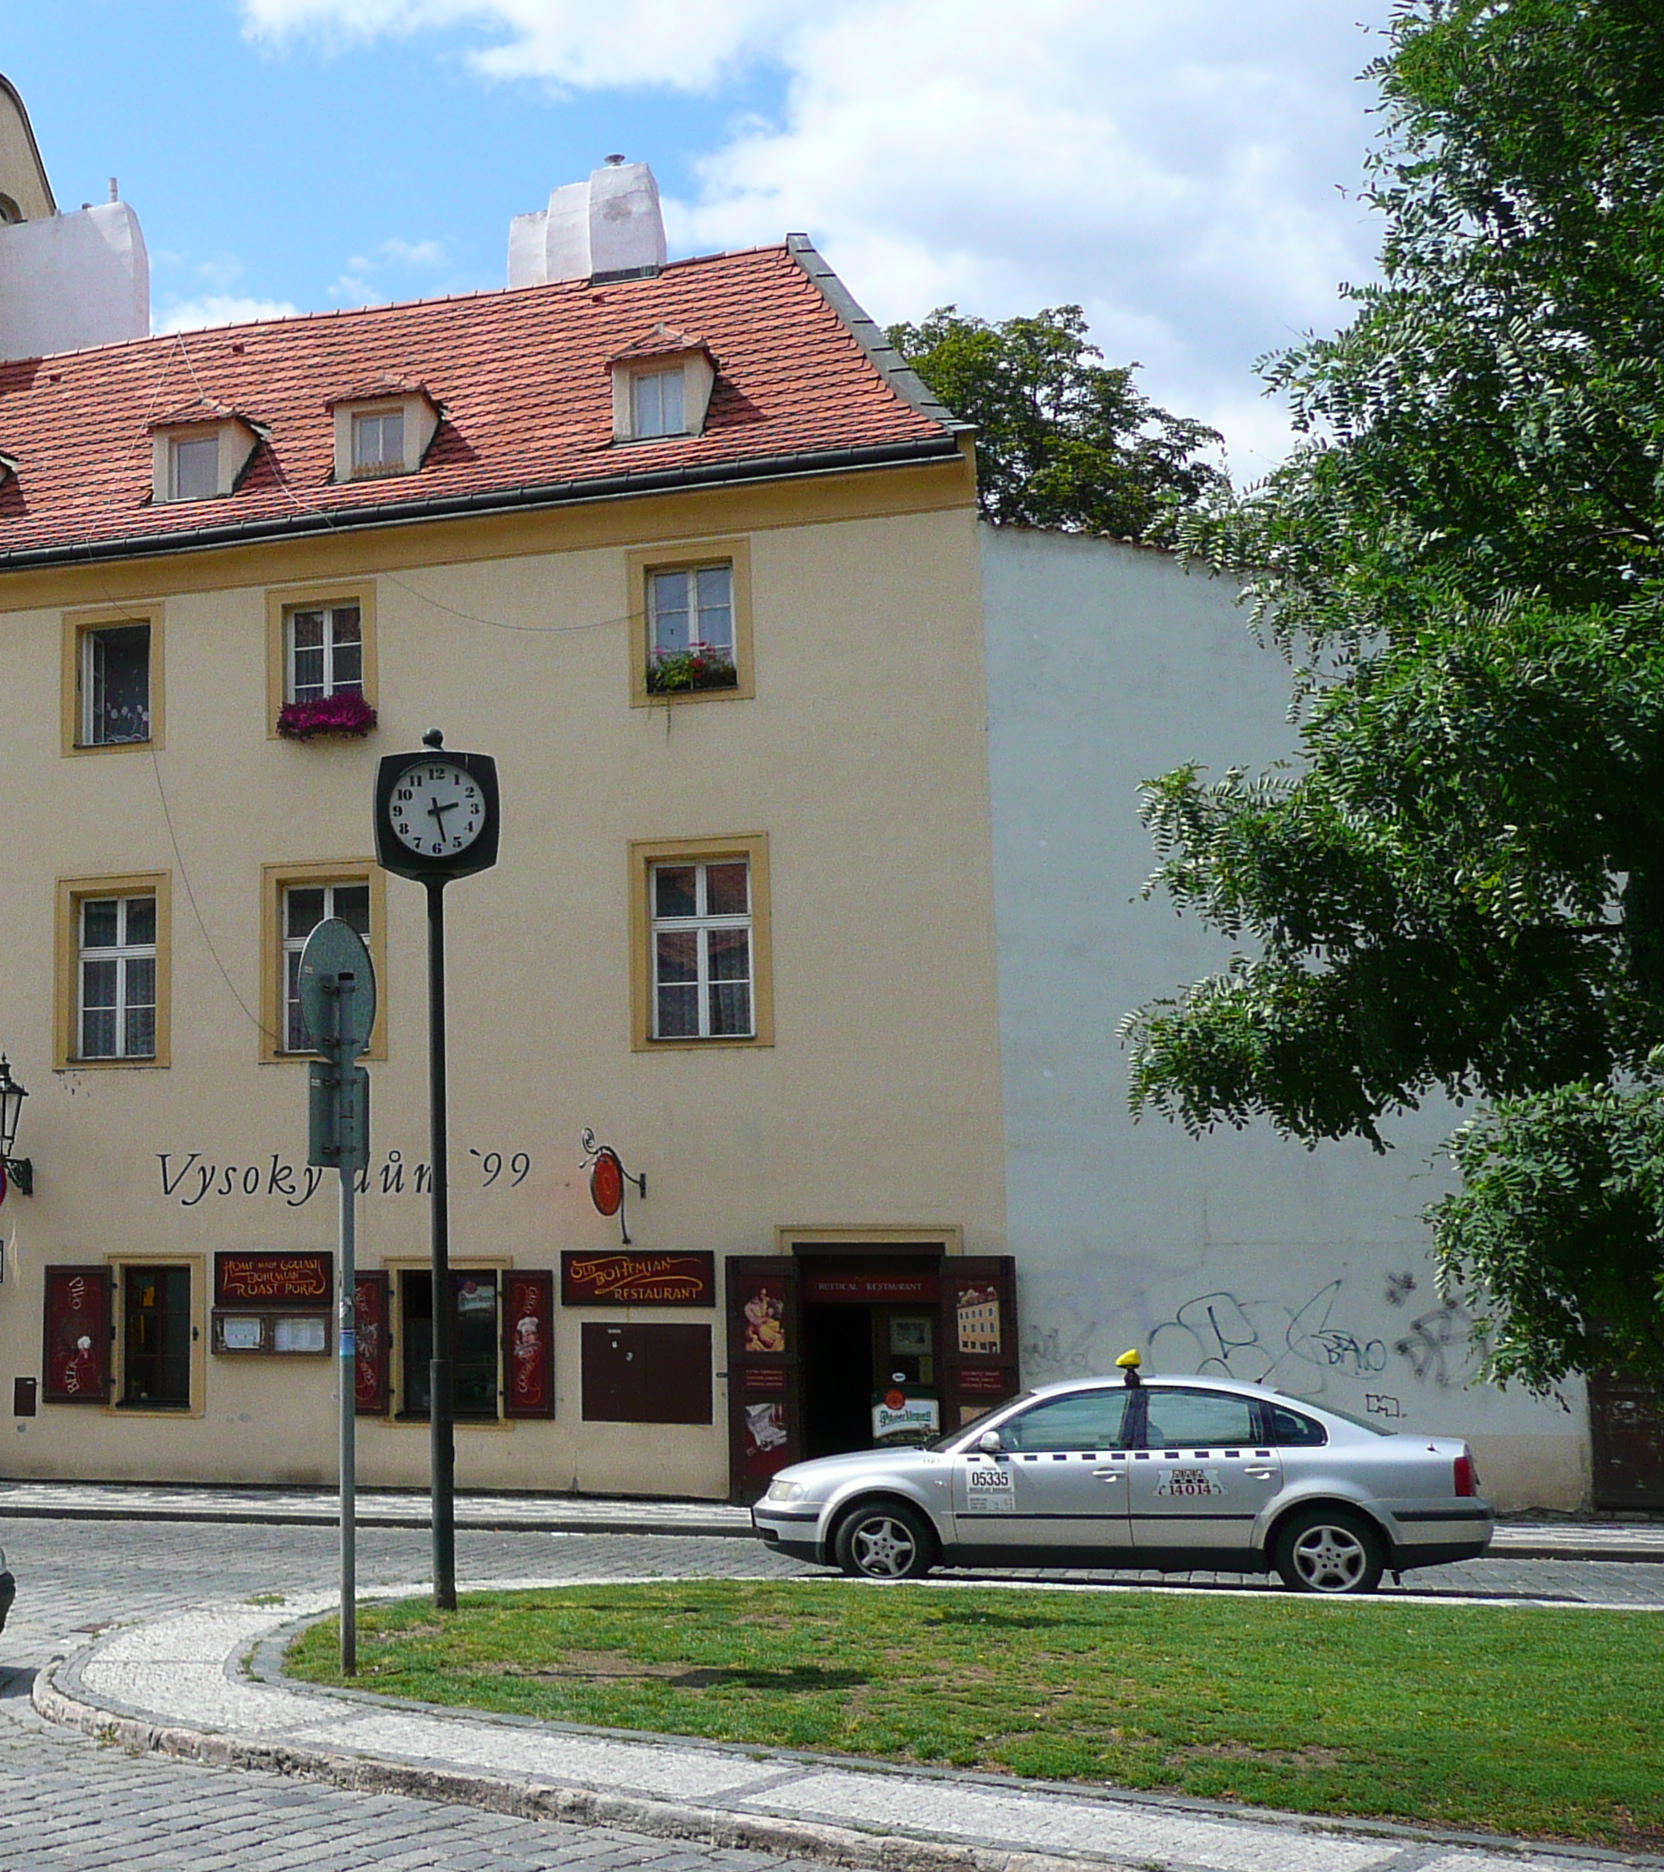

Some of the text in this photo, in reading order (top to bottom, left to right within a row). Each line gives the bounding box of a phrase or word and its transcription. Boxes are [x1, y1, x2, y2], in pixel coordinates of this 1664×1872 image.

[429, 768, 445, 780] 12
[454, 774, 460, 785] 1
[410, 776, 422, 787] 11
[398, 789, 413, 800] 10
[465, 787, 475, 798] 2
[393, 806, 403, 817] 9
[470, 803, 480, 815] 3
[399, 823, 409, 834] 8
[464, 821, 474, 832] 4
[413, 837, 422, 848] 7
[432, 842, 442, 854] 6
[452, 836, 462, 848] 5
[223, 1260, 254, 1274] HOME
[570, 1263, 597, 1279] OLD
[596, 1257, 672, 1287] BOHEMIAN
[247, 1271, 300, 1284] BOHEMIAN
[235, 1284, 317, 1297] ROAST PORK
[866, 1282, 923, 1291] RESTAURANT
[614, 1286, 699, 1300] RESTAURANT
[971, 1471, 1009, 1487] 05335
[1169, 1484, 1212, 1496] 14014
